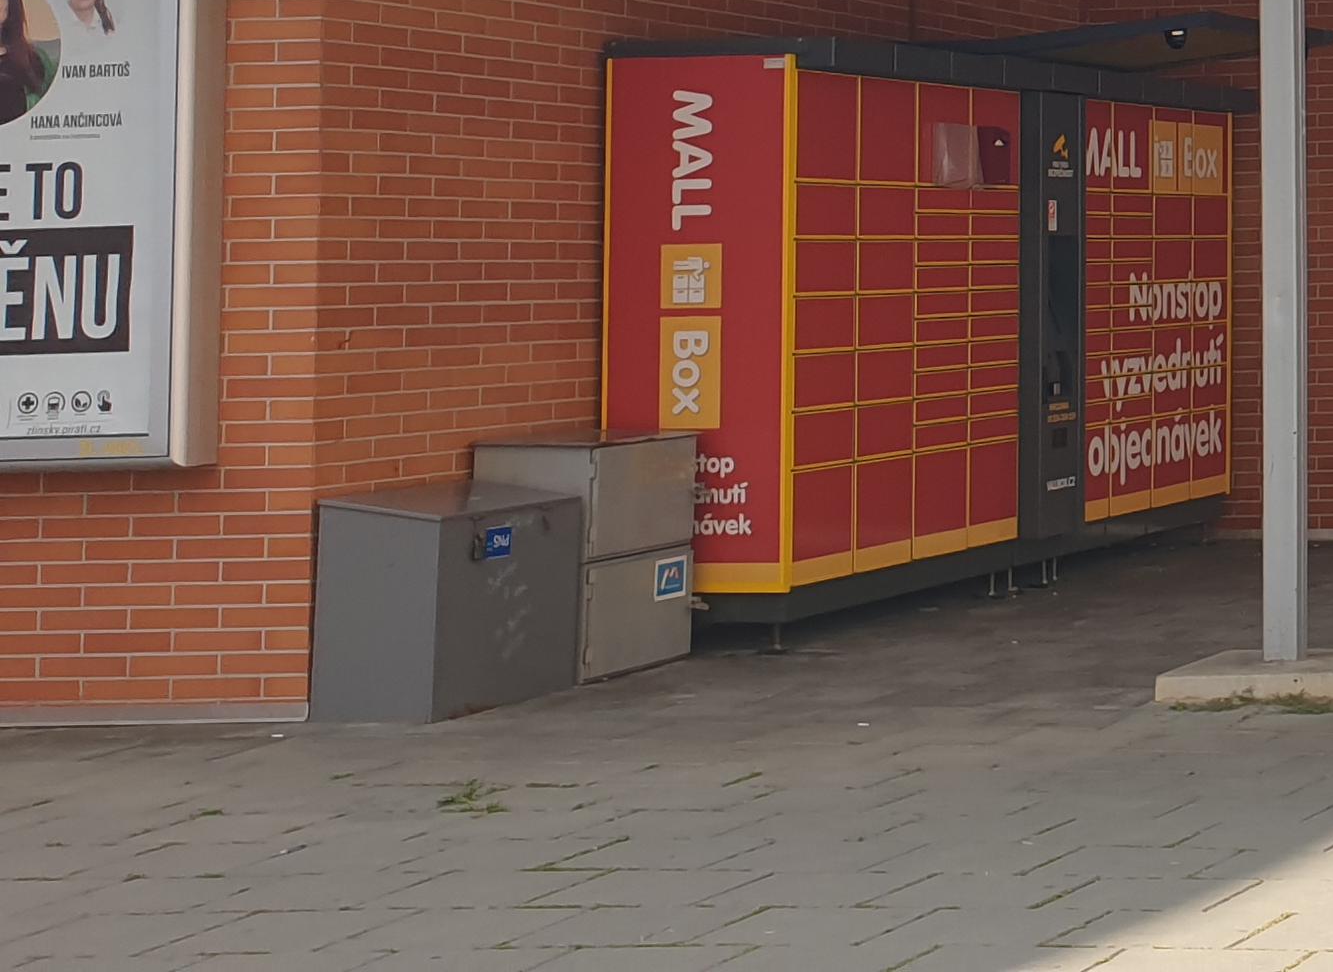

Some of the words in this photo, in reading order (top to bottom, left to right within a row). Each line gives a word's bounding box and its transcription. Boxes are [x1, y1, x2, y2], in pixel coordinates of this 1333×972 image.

[62, 65, 87, 79] IVAN
[89, 61, 131, 77] BARTOŠ
[30, 114, 60, 129] HANA
[672, 89, 713, 231] MALL
[1184, 136, 1218, 179] Box
[26, 162, 83, 220] TO
[1128, 271, 1223, 330] Nonstop
[672, 330, 709, 415] Box
[695, 453, 734, 478] top
[1088, 406, 1222, 486] objednávek
